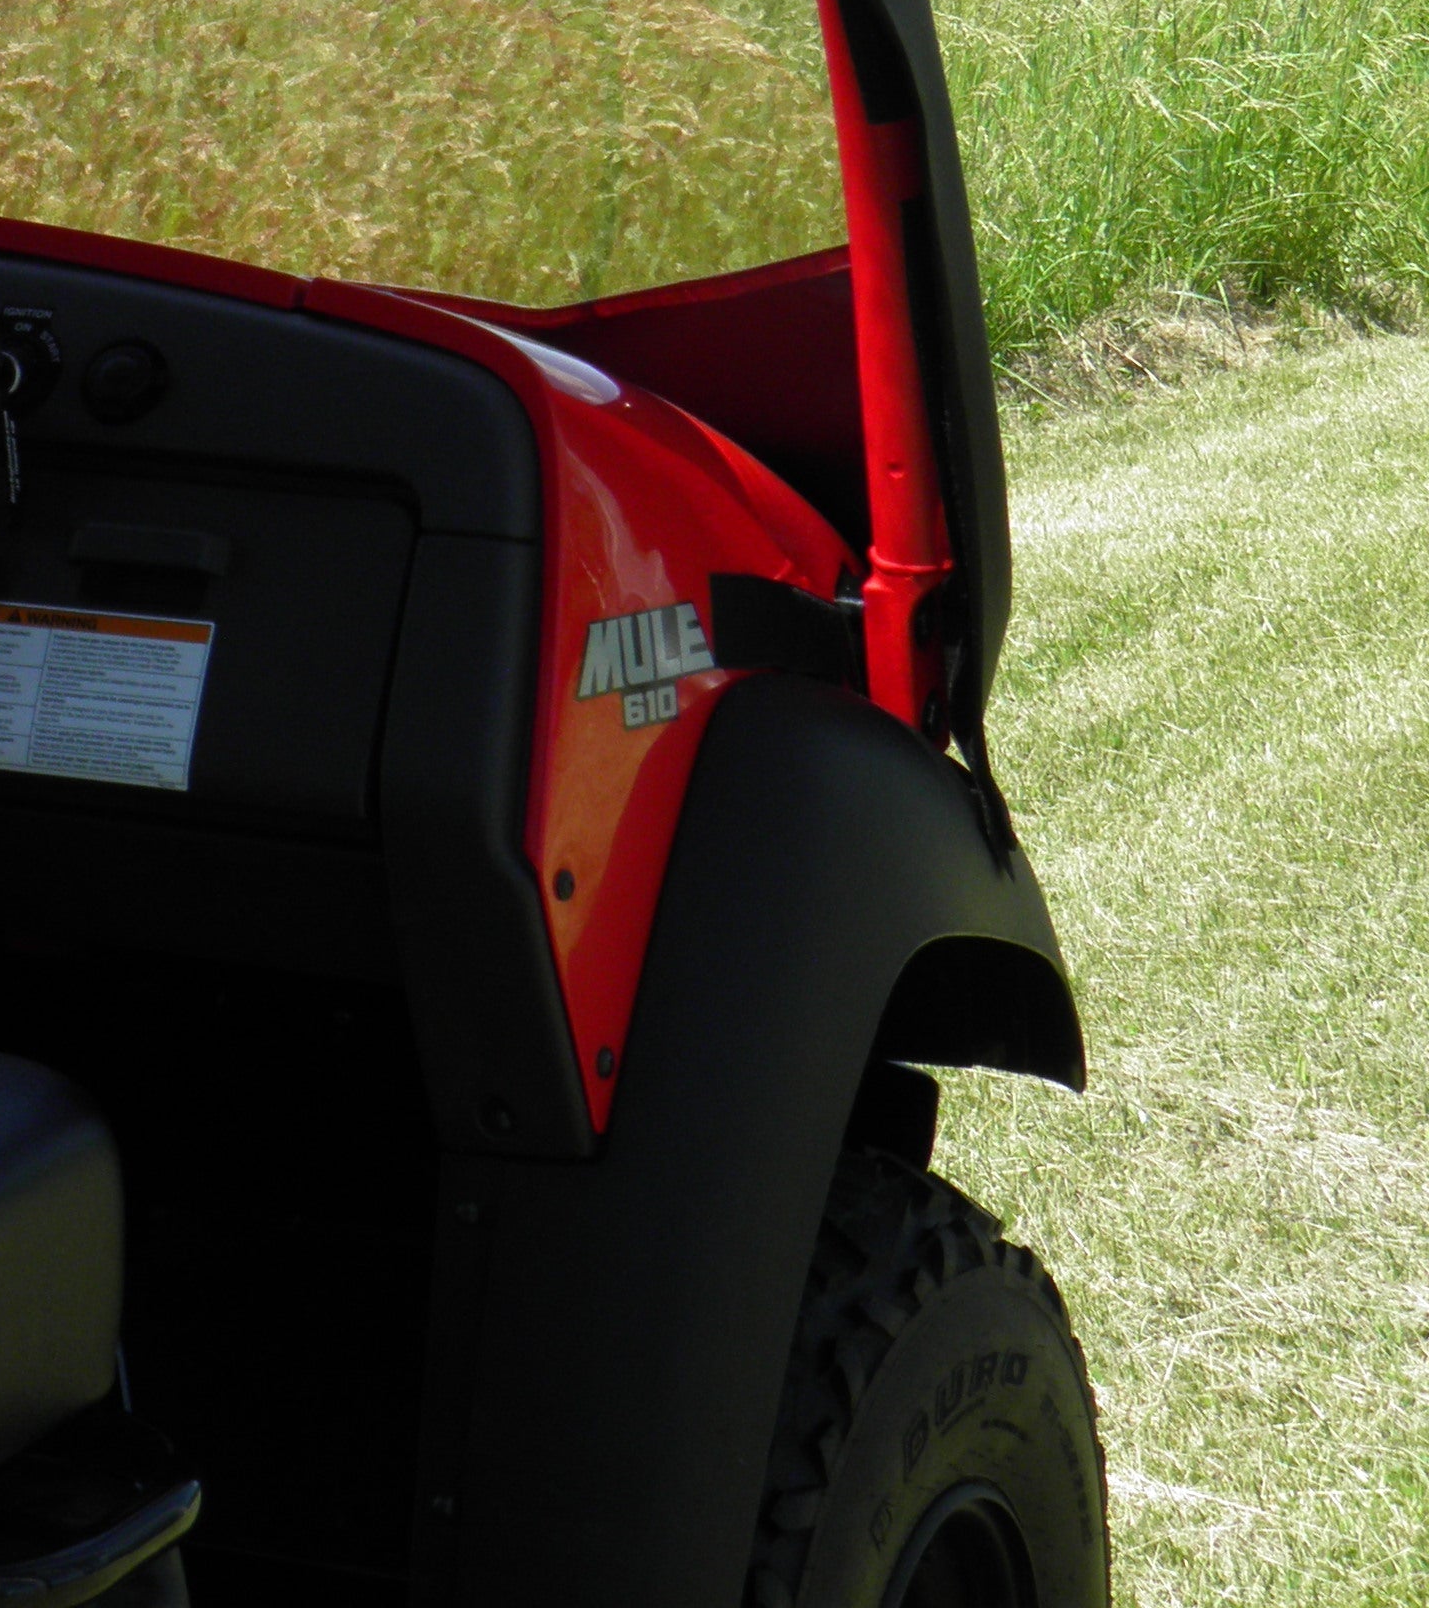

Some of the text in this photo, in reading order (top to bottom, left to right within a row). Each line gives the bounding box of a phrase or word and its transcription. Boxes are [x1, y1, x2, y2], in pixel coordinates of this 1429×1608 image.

[3, 307, 53, 319] IGNITION
[14, 322, 33, 332] ON
[39, 330, 61, 363] START
[27, 611, 98, 631] WARNING
[578, 603, 716, 698] MULE
[623, 685, 678, 728] 610
[903, 1350, 1029, 1484] DURO
